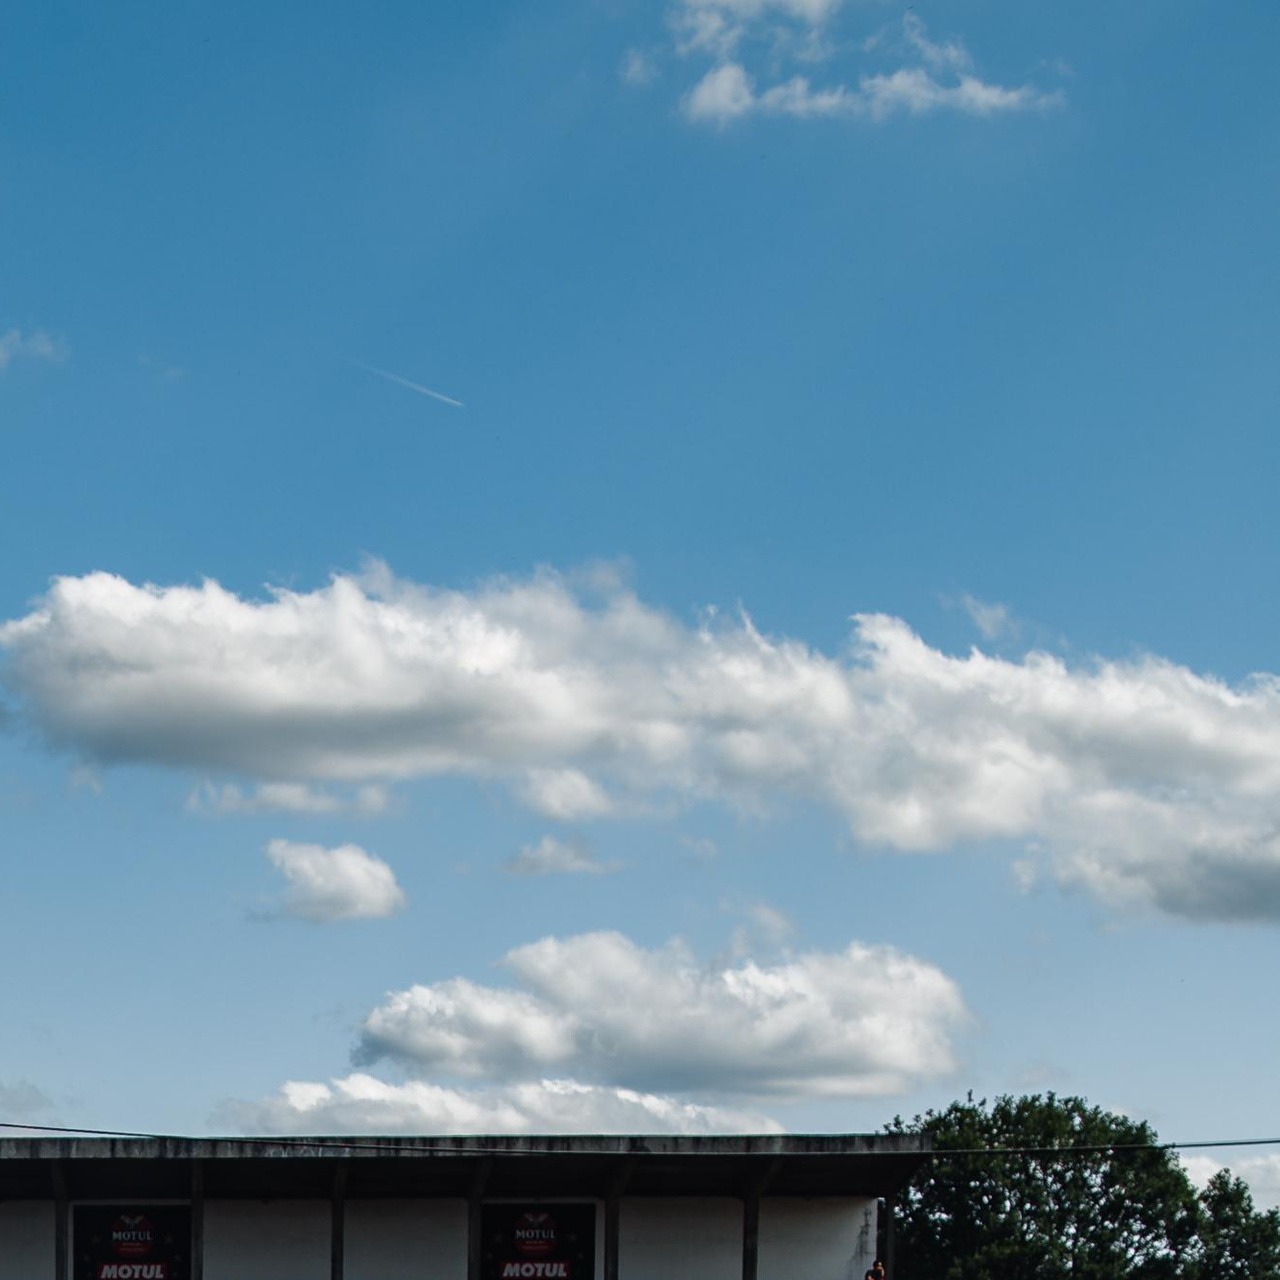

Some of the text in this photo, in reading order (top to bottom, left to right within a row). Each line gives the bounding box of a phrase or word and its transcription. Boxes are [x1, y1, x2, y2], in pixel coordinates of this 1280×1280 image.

[112, 1231, 153, 1240] MOTUL
[516, 1229, 556, 1239] MOTUL
[101, 1264, 164, 1279] MOTUL
[503, 1262, 567, 1277] MOTUL
